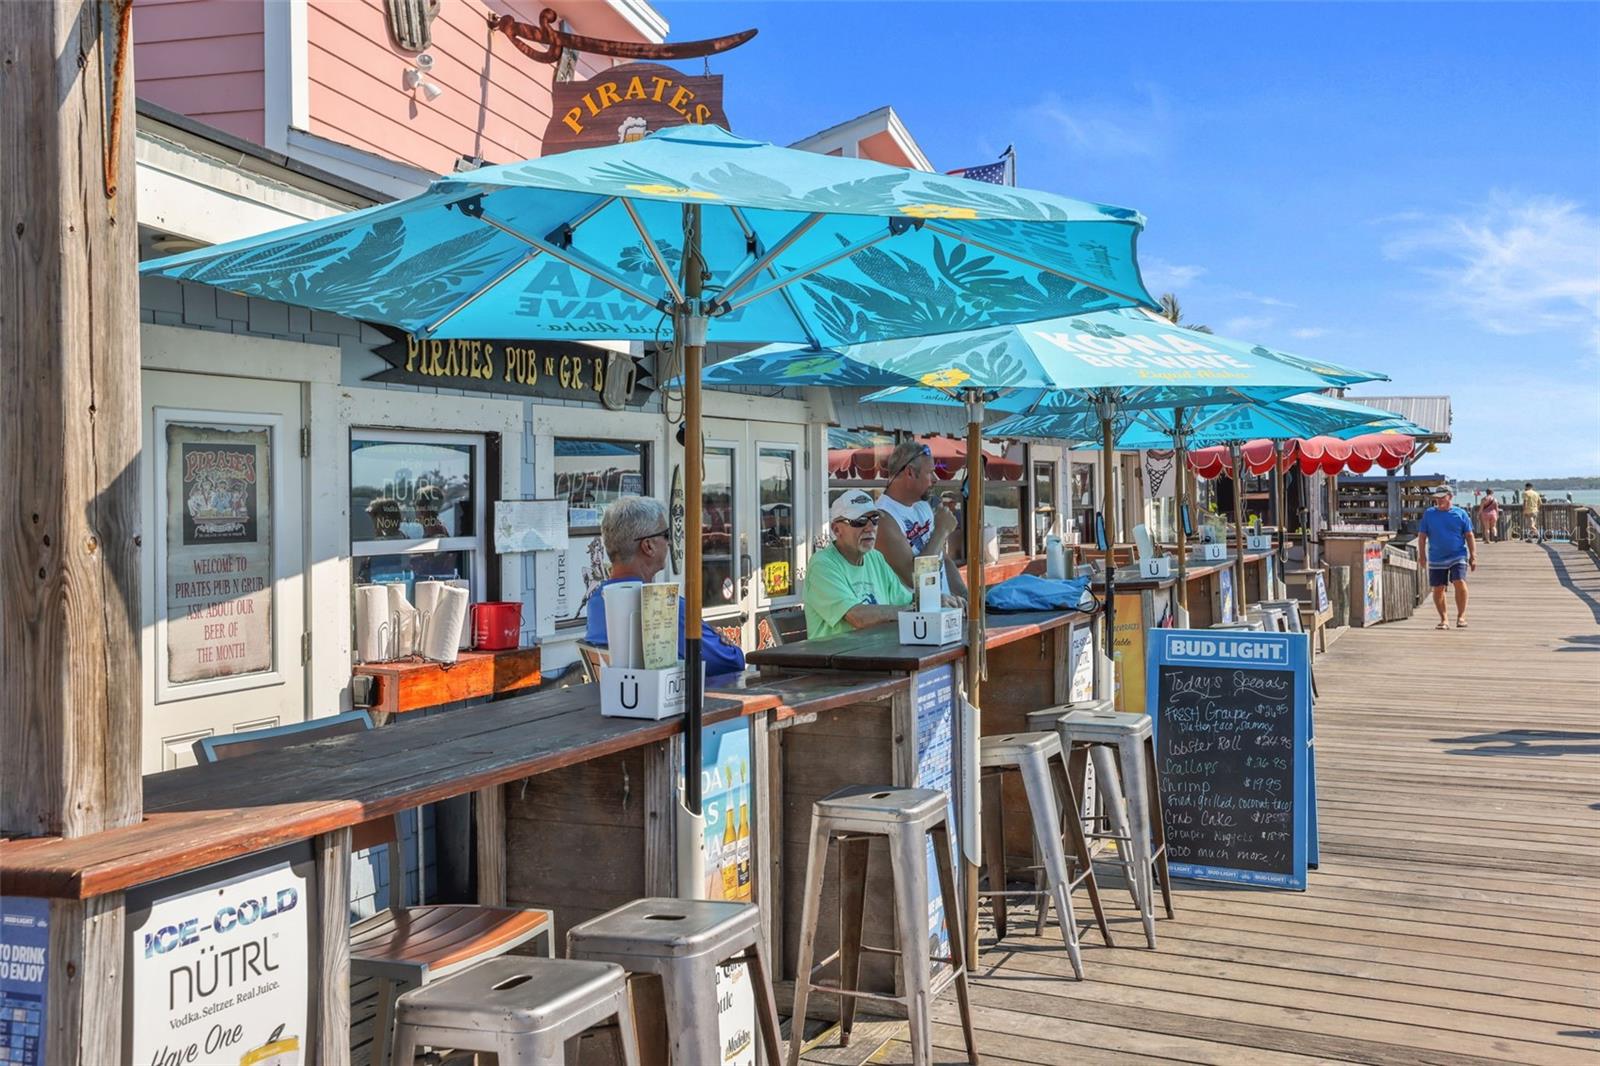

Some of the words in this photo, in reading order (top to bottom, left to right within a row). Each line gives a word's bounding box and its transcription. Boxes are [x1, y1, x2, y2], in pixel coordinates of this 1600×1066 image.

[562, 76, 712, 135] PIRATES
[1032, 331, 1218, 355] KONA
[405, 333, 494, 380] PIRATES
[504, 347, 538, 386] PUB
[1143, 354, 1256, 369] WAVE
[376, 516, 399, 529] Now
[193, 556, 233, 575] WELCOME
[236, 556, 248, 572] TO
[1149, 560, 1159, 576] Ü
[175, 580, 211, 599] PIRATES
[213, 579, 231, 595] PUB
[233, 578, 239, 593] N
[241, 576, 264, 593] GRUB
[187, 603, 204, 620] ASK
[205, 600, 234, 619] ABOUT
[236, 599, 255, 615] OUR
[204, 623, 226, 641] BEER
[227, 621, 239, 638] OF
[913, 615, 928, 640] Ü
[197, 647, 214, 664] THE
[215, 642, 245, 661] MONTH
[1171, 639, 1217, 657] BUD
[1218, 641, 1284, 660] LIGHT
[620, 674, 639, 710] Ü
[1169, 739, 1214, 756] Lobster
[1217, 735, 1242, 751] Roll
[1161, 777, 1211, 796] Shrimp
[1198, 846, 1230, 860] much
[144, 887, 299, 960] ICE-COLD
[12, 945, 46, 965] DRINK
[10, 964, 45, 983] ENJOY
[169, 1009, 202, 1030] Vodka.
[236, 988, 255, 1005] Real
[256, 979, 280, 997] Juice.
[152, 1043, 199, 1066] Have
[204, 1023, 243, 1054] One
